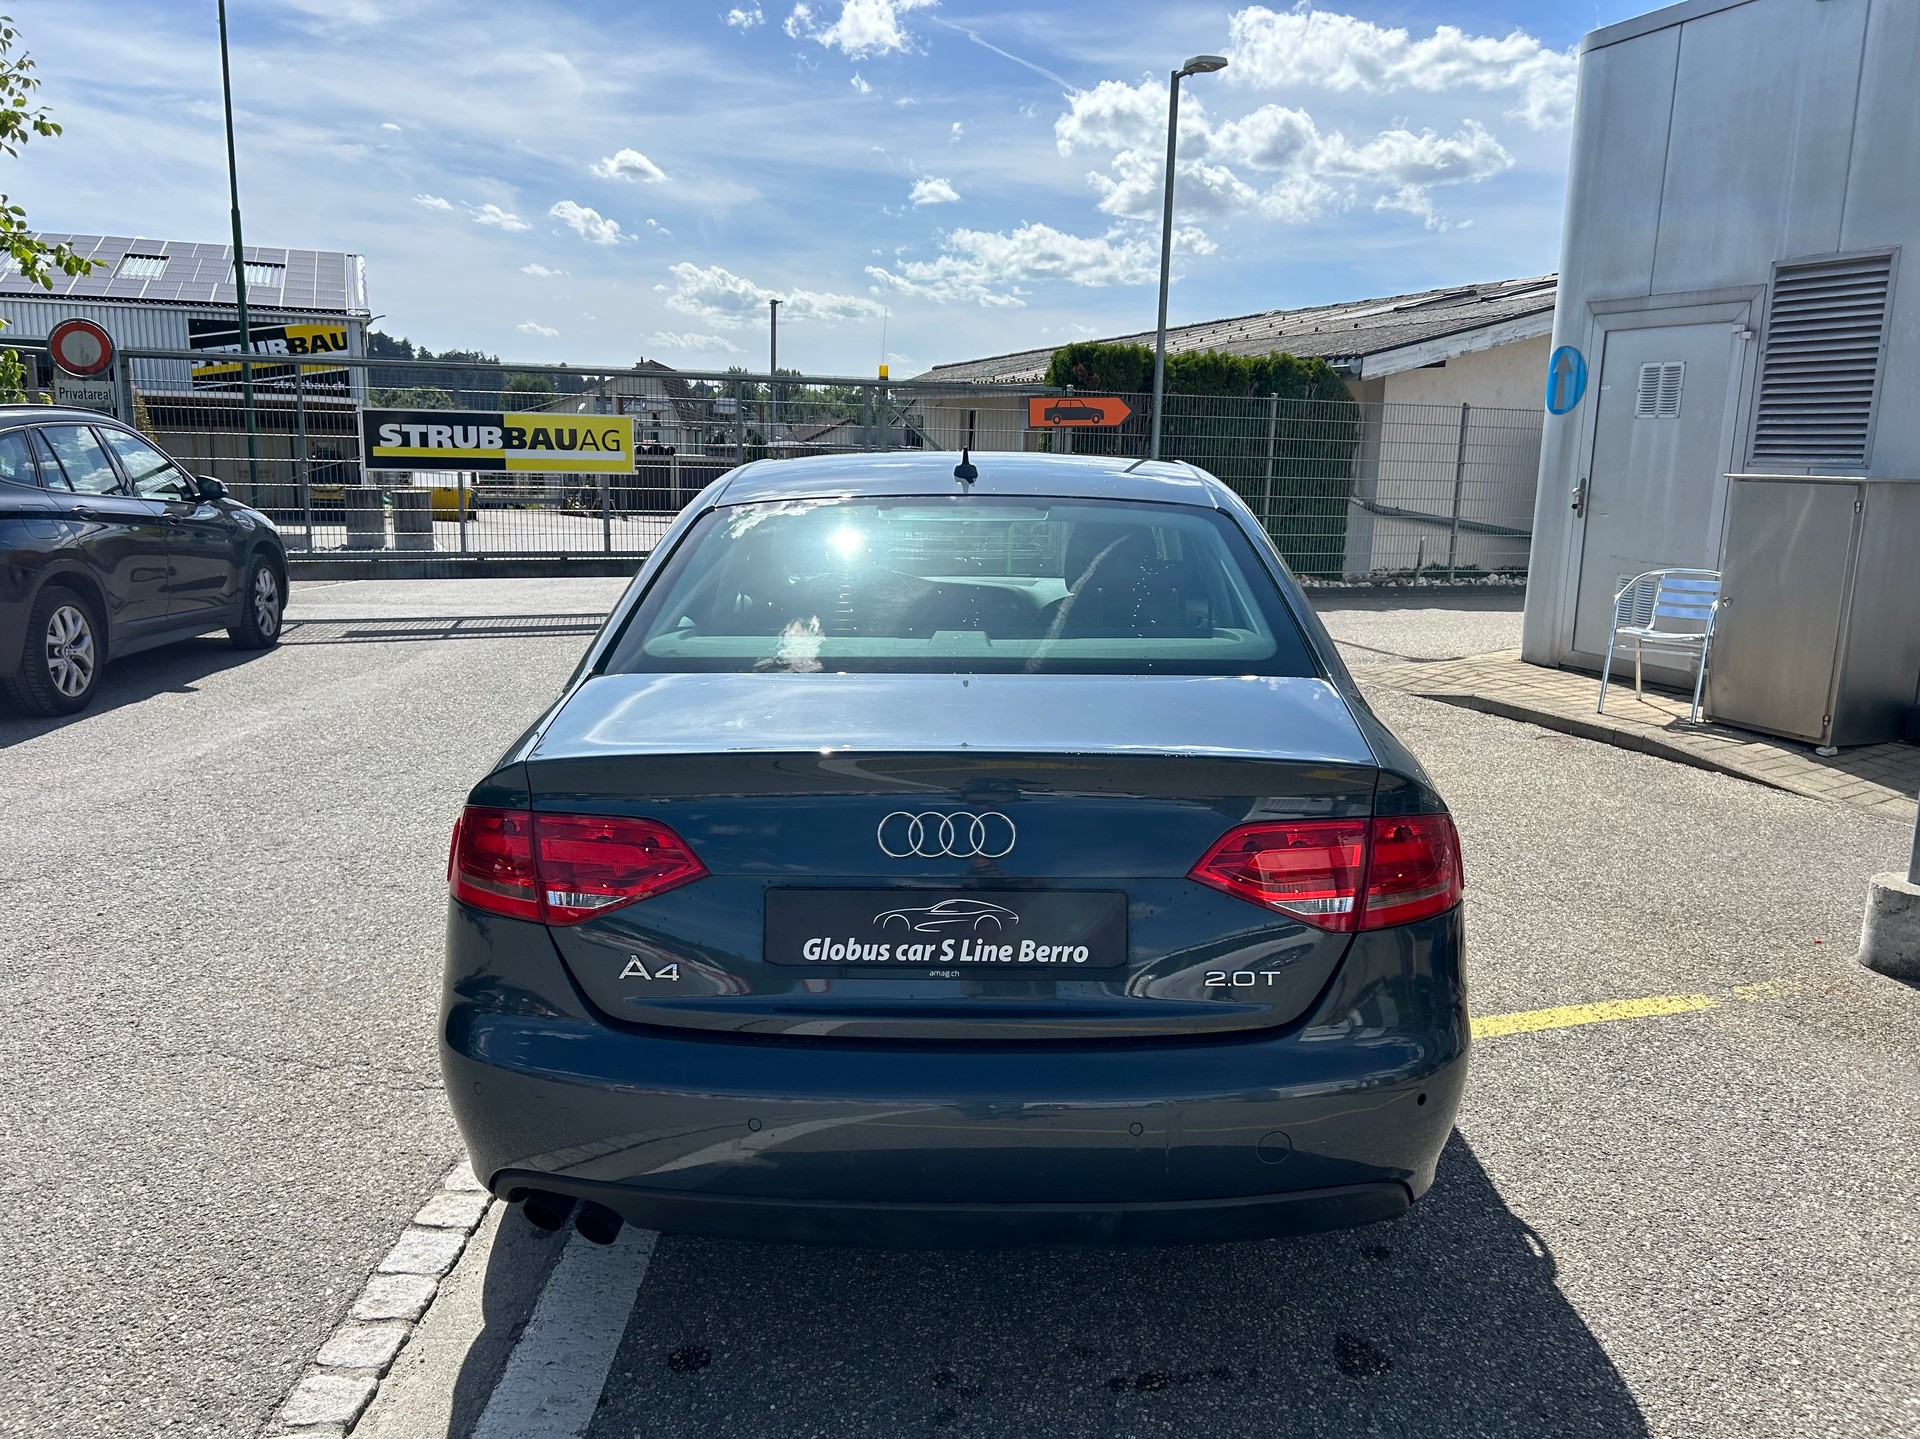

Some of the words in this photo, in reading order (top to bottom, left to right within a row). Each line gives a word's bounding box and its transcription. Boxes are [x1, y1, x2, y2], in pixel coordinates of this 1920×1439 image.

[59, 387, 112, 400] Privatareal
[803, 938, 890, 961] Globus
[895, 943, 936, 961] car
[939, 939, 954, 961] S
[960, 939, 1012, 962] Line
[1018, 940, 1089, 963] Berro
[618, 954, 680, 981] A4
[929, 970, 960, 978] amag.ch
